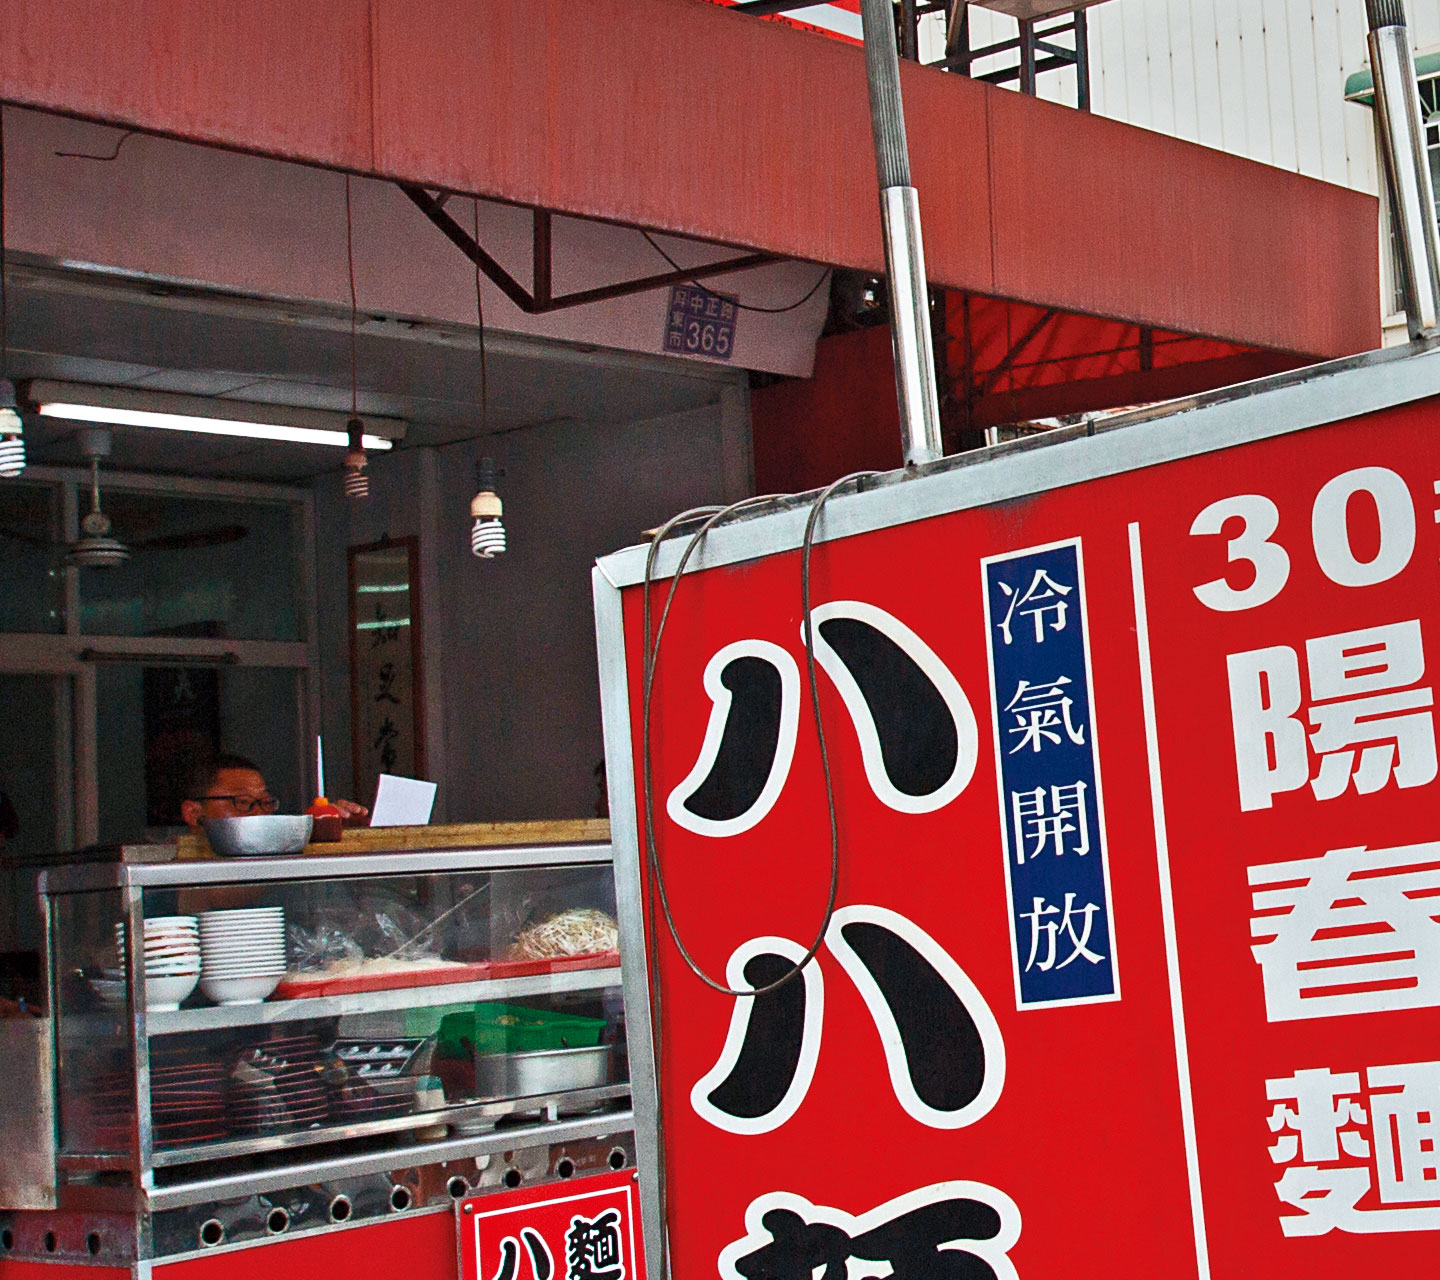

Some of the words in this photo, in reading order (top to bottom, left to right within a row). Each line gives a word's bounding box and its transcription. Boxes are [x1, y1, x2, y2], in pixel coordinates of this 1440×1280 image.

[687, 321, 730, 354] 365
[997, 568, 1106, 974] 冷氣開放
